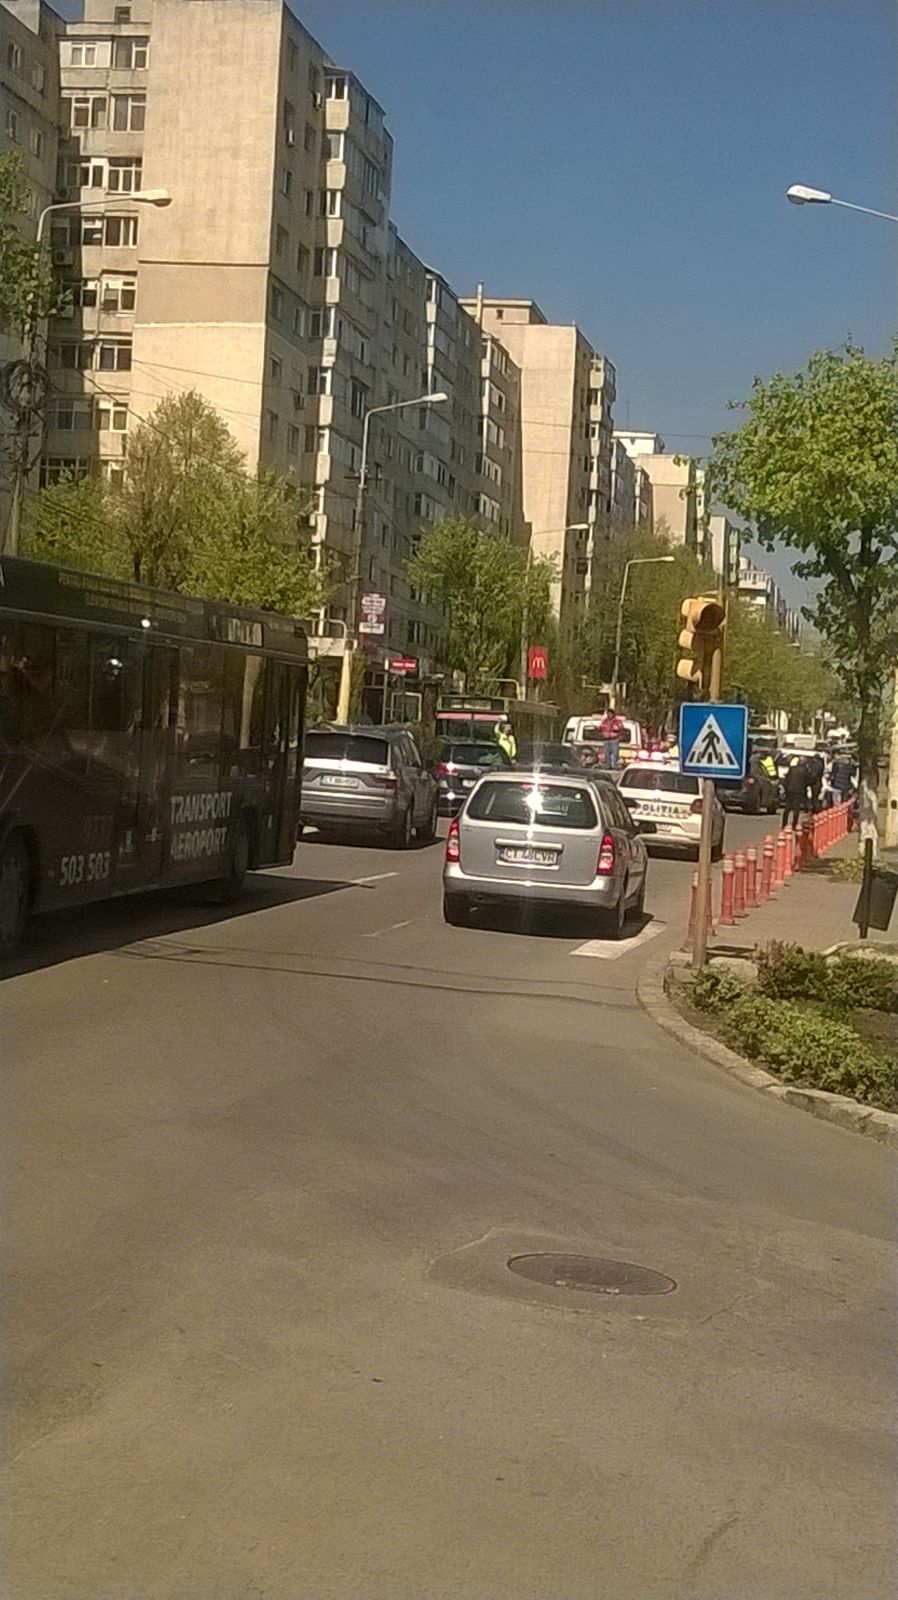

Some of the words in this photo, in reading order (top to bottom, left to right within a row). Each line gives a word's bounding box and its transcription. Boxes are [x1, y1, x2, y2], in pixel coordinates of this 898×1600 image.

[170, 791, 233, 824] TRANSPORT
[169, 826, 228, 860] AEROPORT
[60, 854, 84, 886] 503
[87, 851, 111, 882] 503
